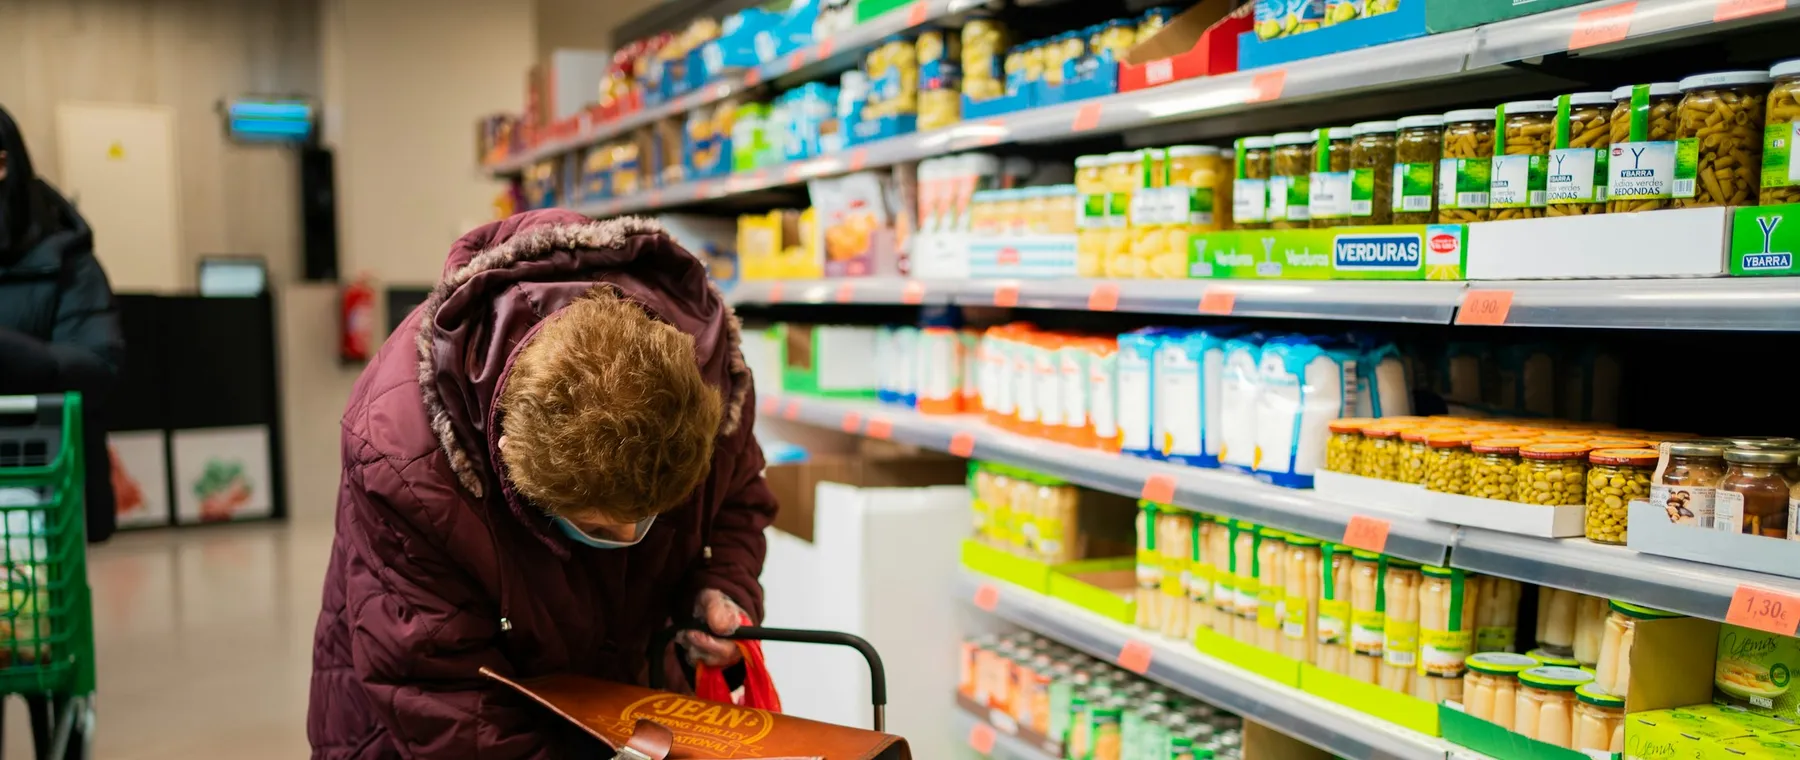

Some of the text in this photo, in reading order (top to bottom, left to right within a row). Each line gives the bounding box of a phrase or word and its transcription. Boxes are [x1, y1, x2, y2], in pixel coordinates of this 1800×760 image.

[1636, 178, 1664, 187] verdes
[1615, 187, 1660, 196] REDONDAS
[1337, 241, 1418, 262] VERDURAS
[1745, 255, 1789, 267] YBARRA
[655, 698, 752, 728] JEAN
[692, 724, 749, 740] TROLLEY
